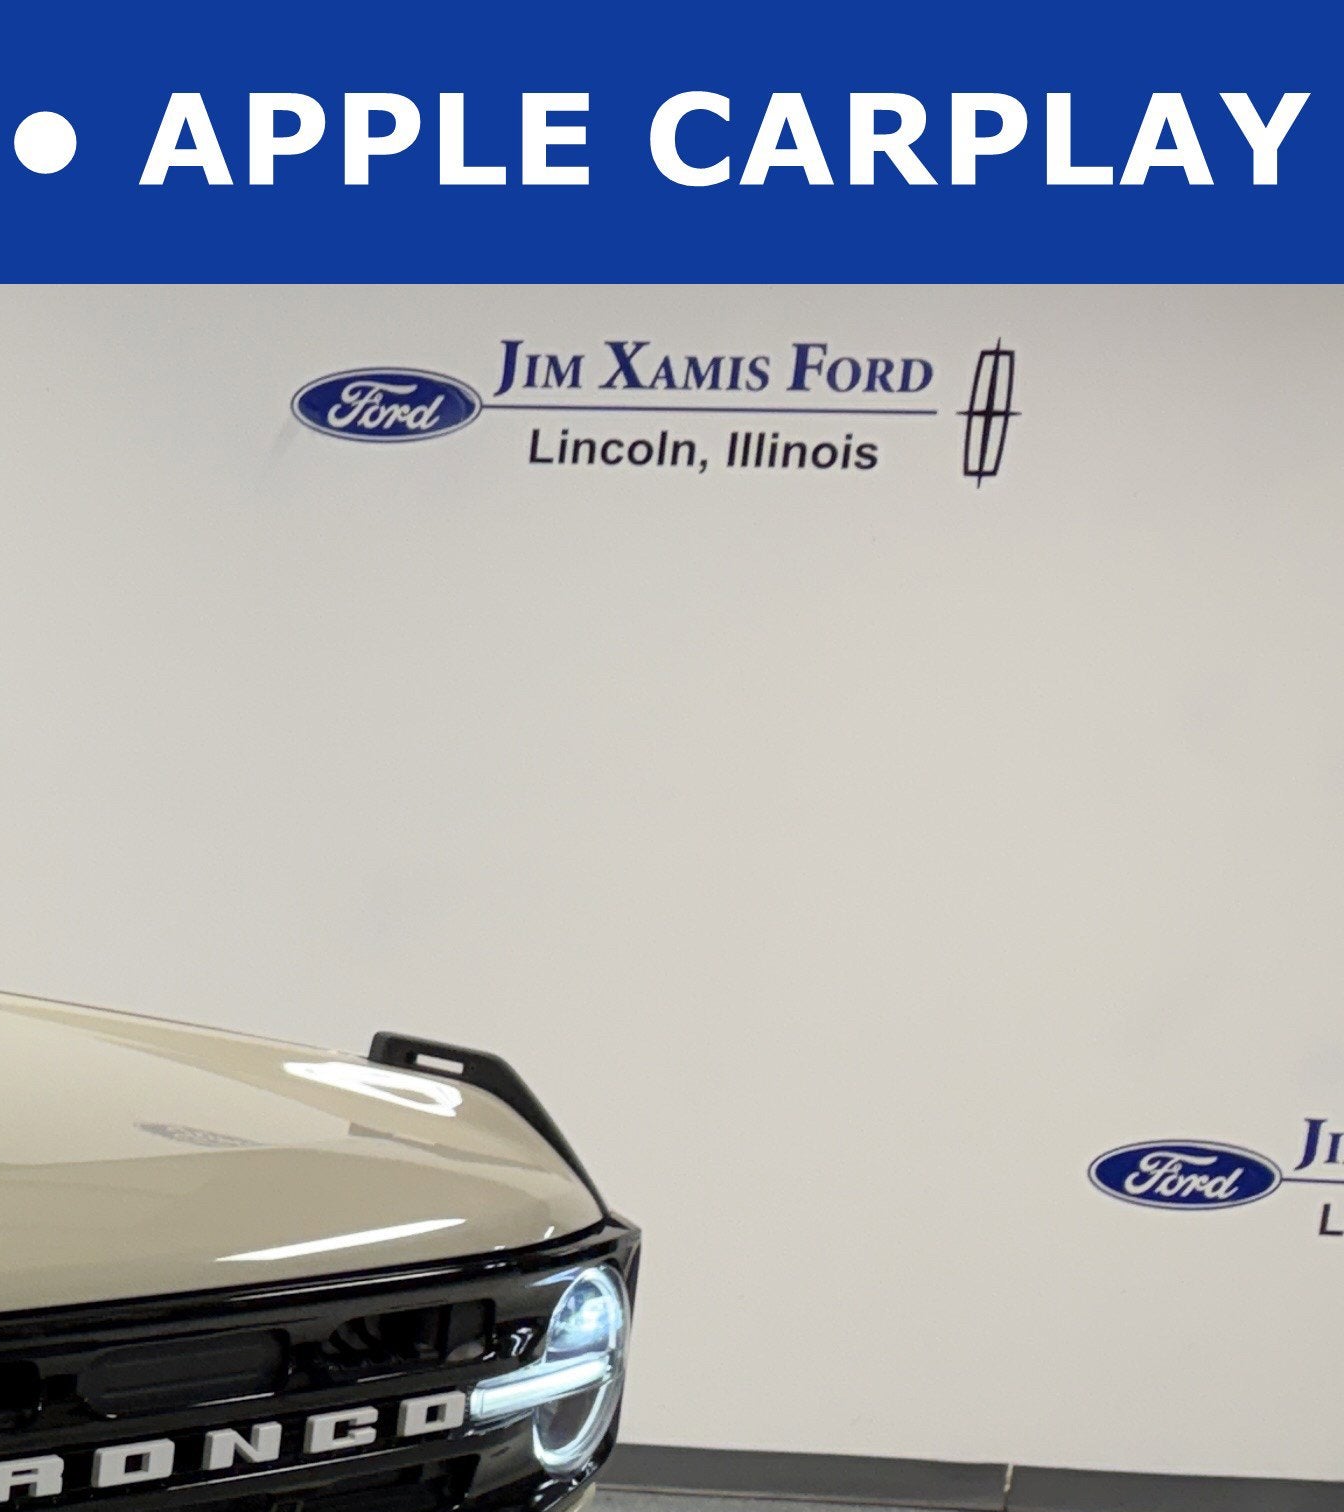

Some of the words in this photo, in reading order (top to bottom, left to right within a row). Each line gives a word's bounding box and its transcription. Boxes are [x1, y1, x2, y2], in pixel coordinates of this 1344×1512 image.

[493, 338, 585, 398] JIM
[598, 340, 770, 393] XAMIS
[786, 341, 935, 395] FORD
[326, 380, 441, 432] Ford
[528, 428, 710, 475] Lincoln,
[725, 432, 880, 470] Illinois
[1123, 1150, 1246, 1201] Ford
